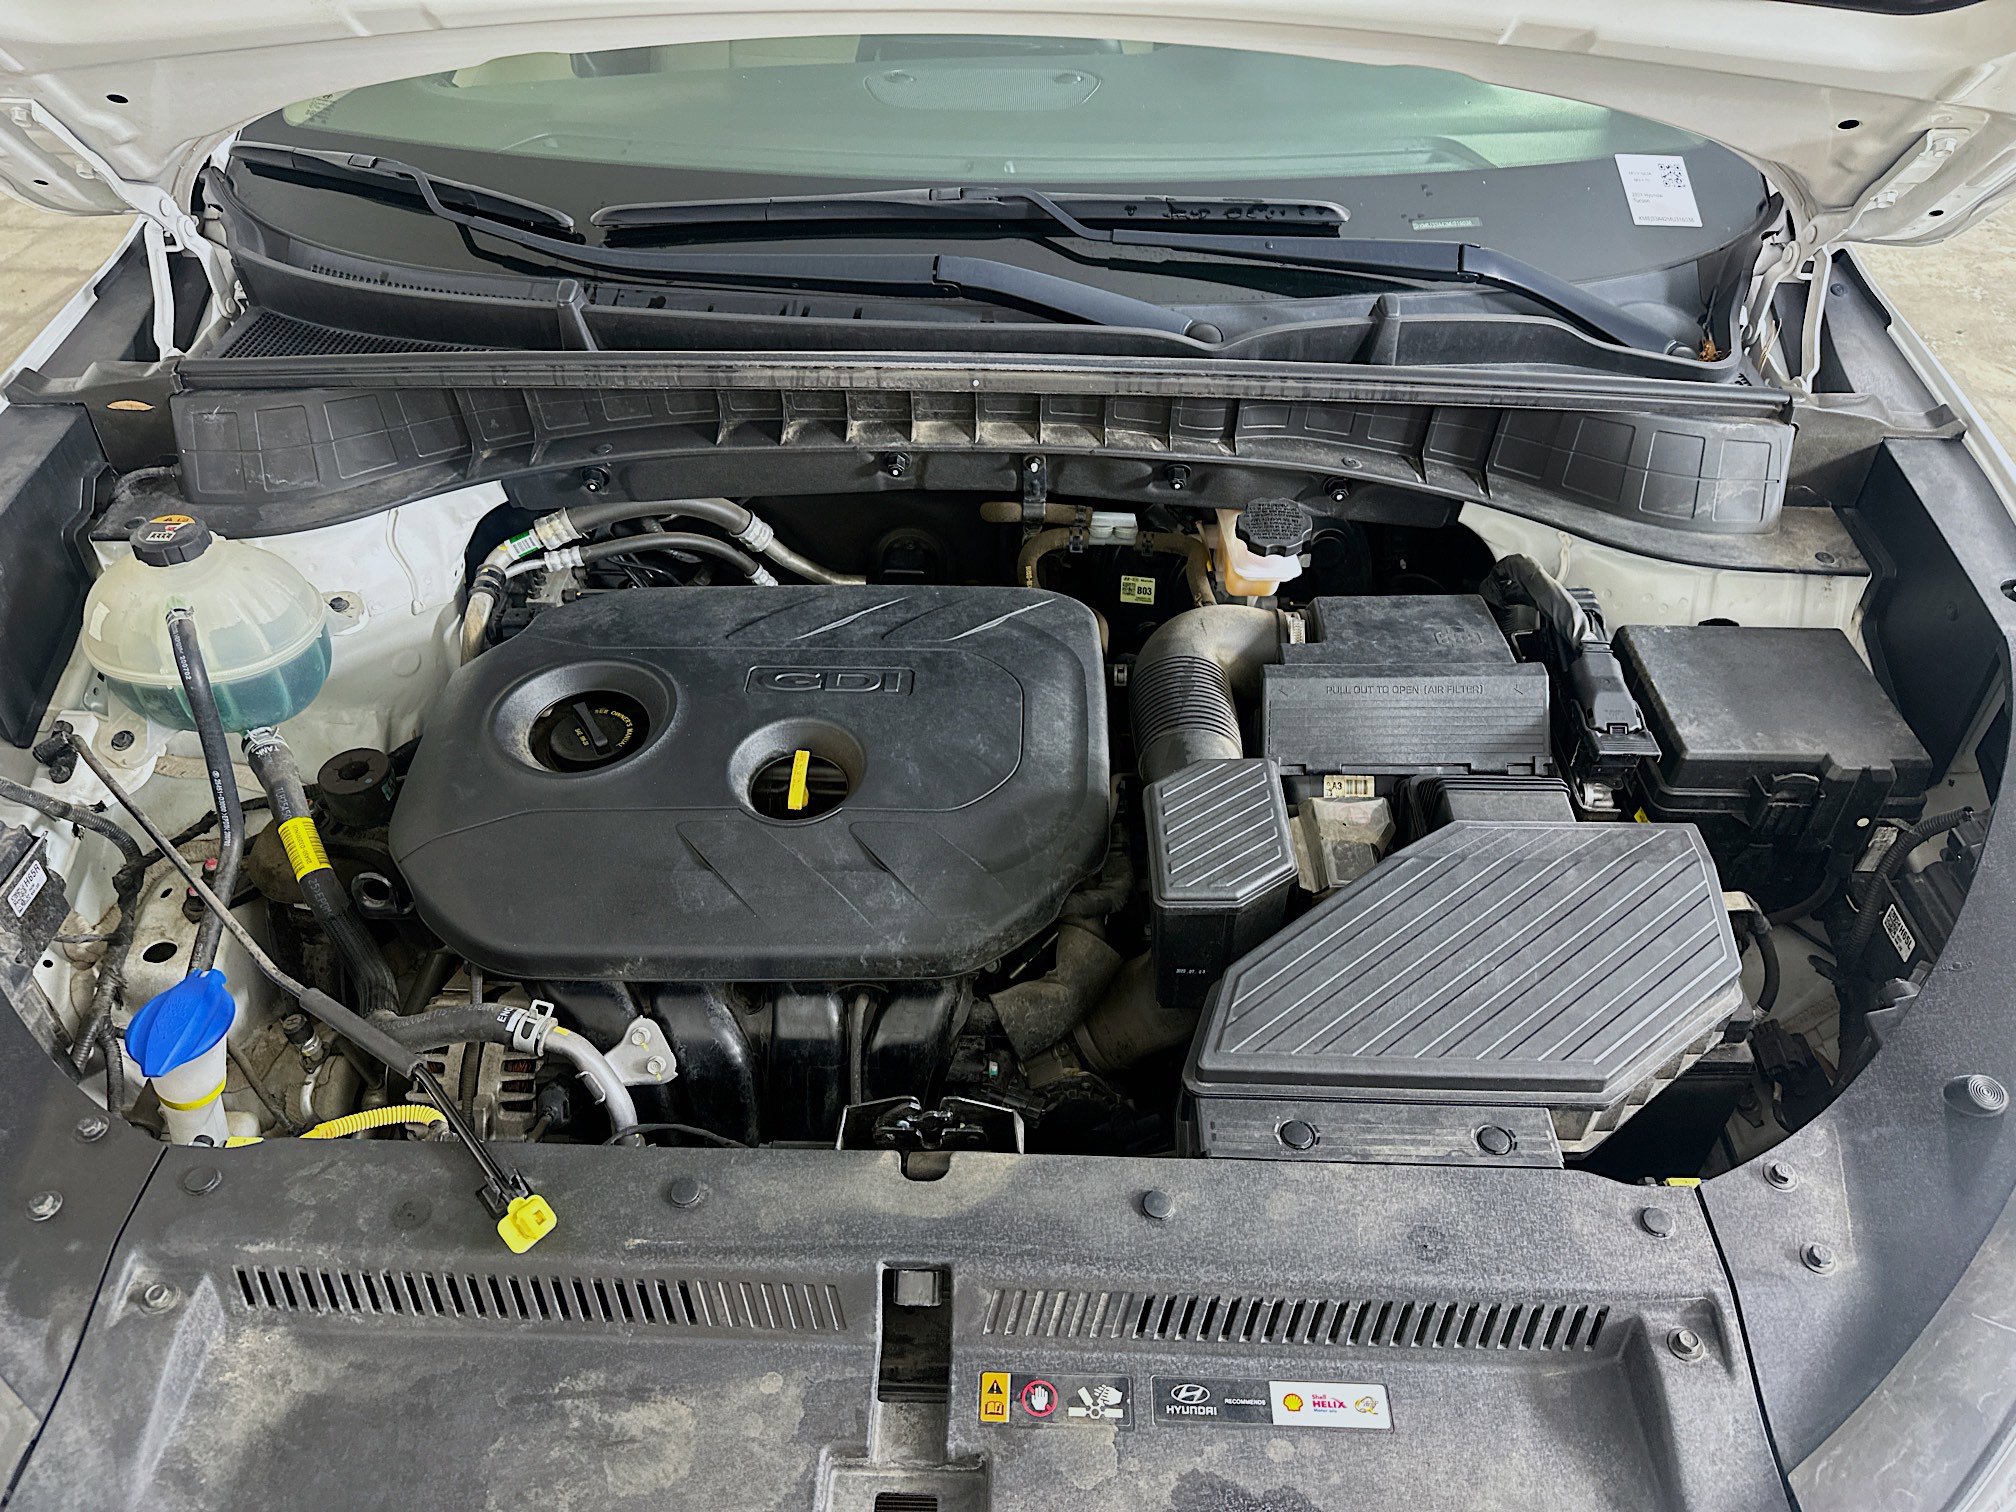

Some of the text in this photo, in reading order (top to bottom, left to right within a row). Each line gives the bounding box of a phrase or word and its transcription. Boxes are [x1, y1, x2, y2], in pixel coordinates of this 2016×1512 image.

[760, 671, 900, 692] GDI
[1326, 685, 1352, 694] PULL
[1353, 685, 1374, 694] OUT
[1376, 685, 1389, 694] TO
[1392, 685, 1419, 694] OPEN
[1447, 684, 1484, 695] FILTER)
[610, 711, 633, 727] OWNER'S
[616, 728, 634, 747] MANUAL
[24, 864, 40, 887] H65R
[1899, 924, 1912, 950] H65L
[1166, 1405, 1217, 1416] HYUNDAI
